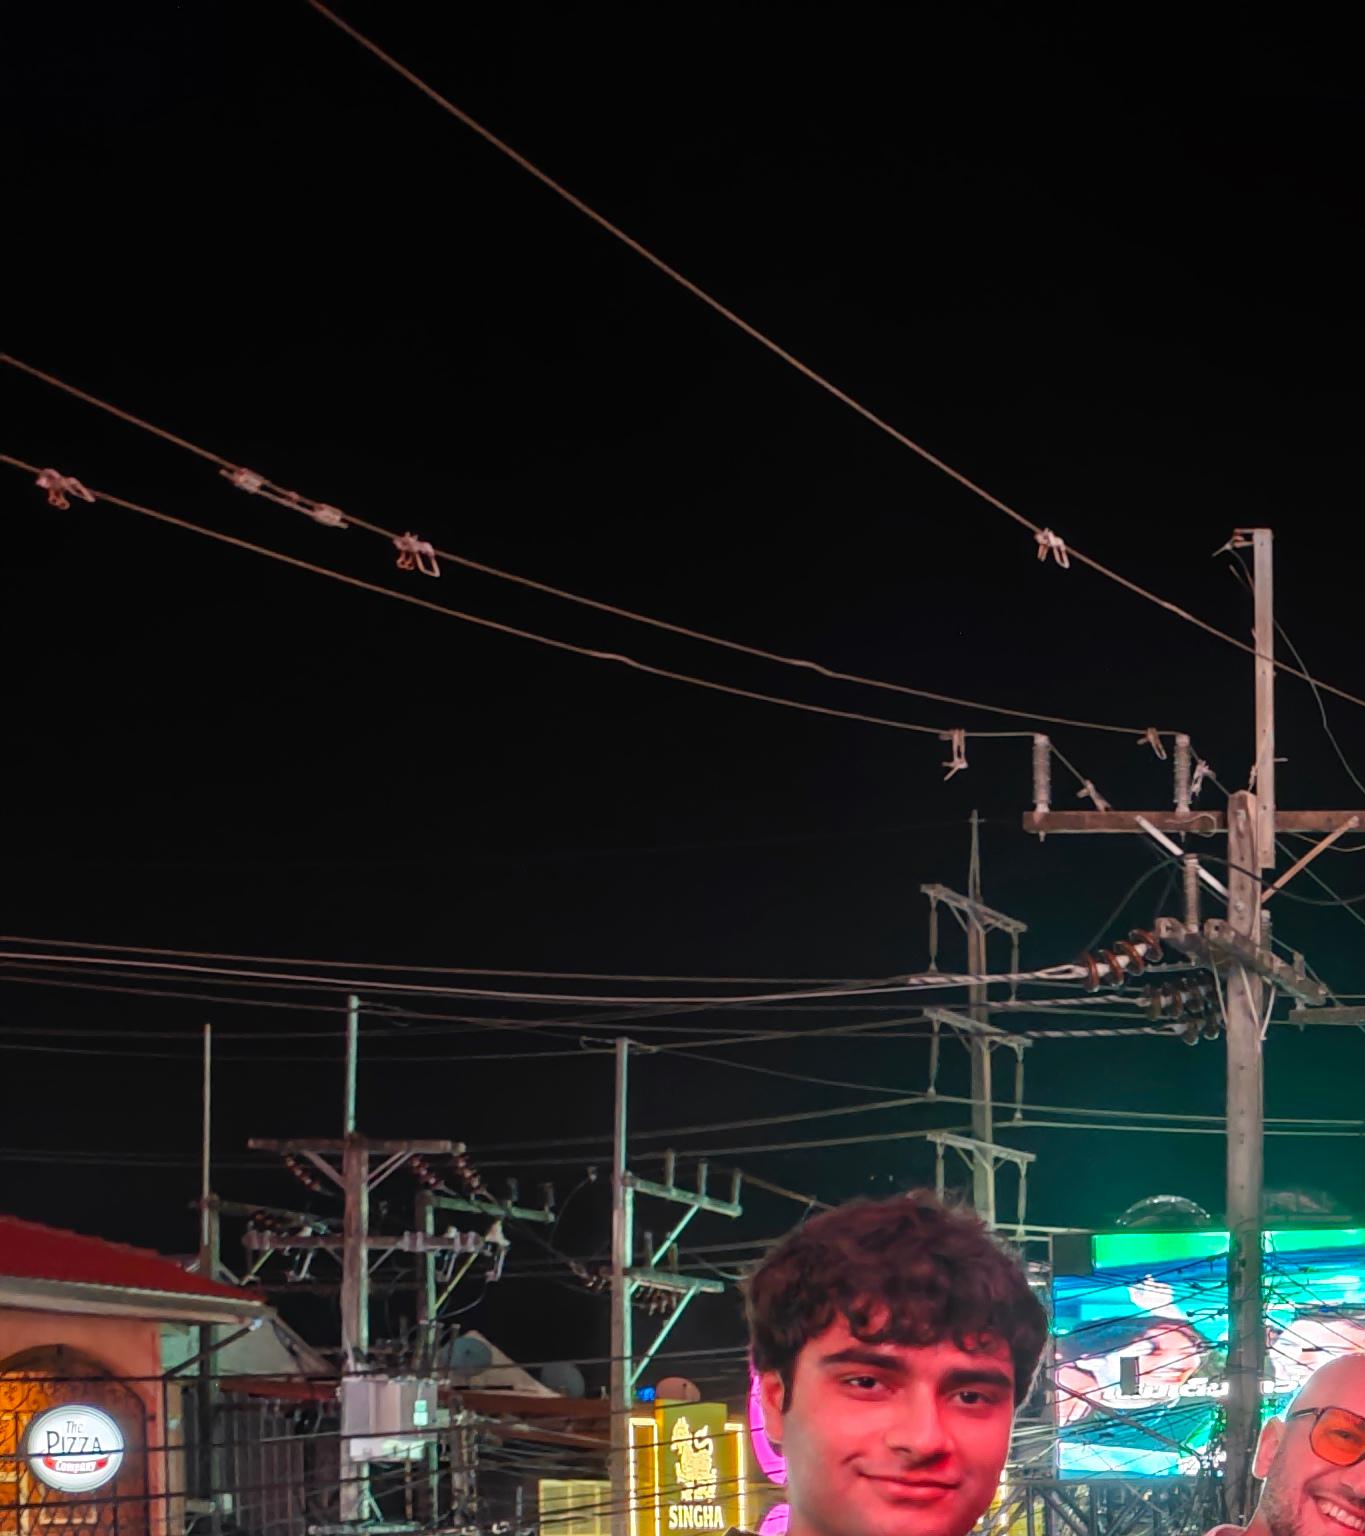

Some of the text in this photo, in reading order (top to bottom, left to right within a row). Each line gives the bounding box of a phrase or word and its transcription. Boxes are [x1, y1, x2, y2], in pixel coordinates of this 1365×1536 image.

[66, 1420, 84, 1433] The
[46, 1430, 102, 1455] PIZZA
[668, 1504, 725, 1529] SINGHA
